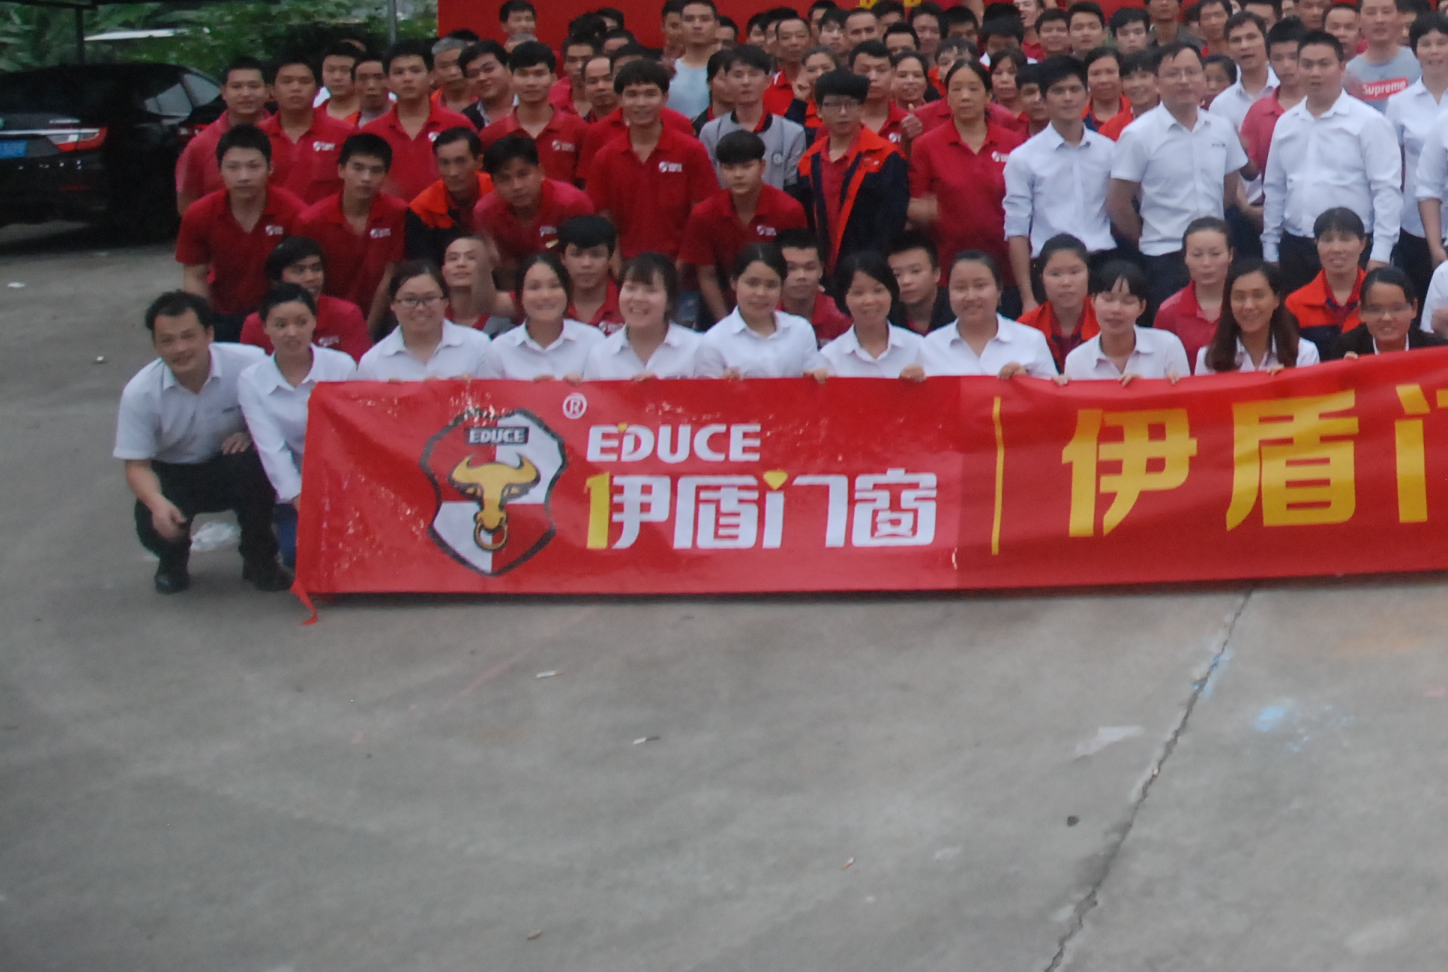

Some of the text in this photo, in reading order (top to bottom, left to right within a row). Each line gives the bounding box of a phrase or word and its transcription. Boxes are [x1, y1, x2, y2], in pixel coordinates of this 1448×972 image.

[1362, 80, 1407, 97] Supreme
[468, 429, 526, 444] EDUCE
[586, 422, 762, 464] EDUCE
[586, 468, 938, 550] 伊盾门窗
